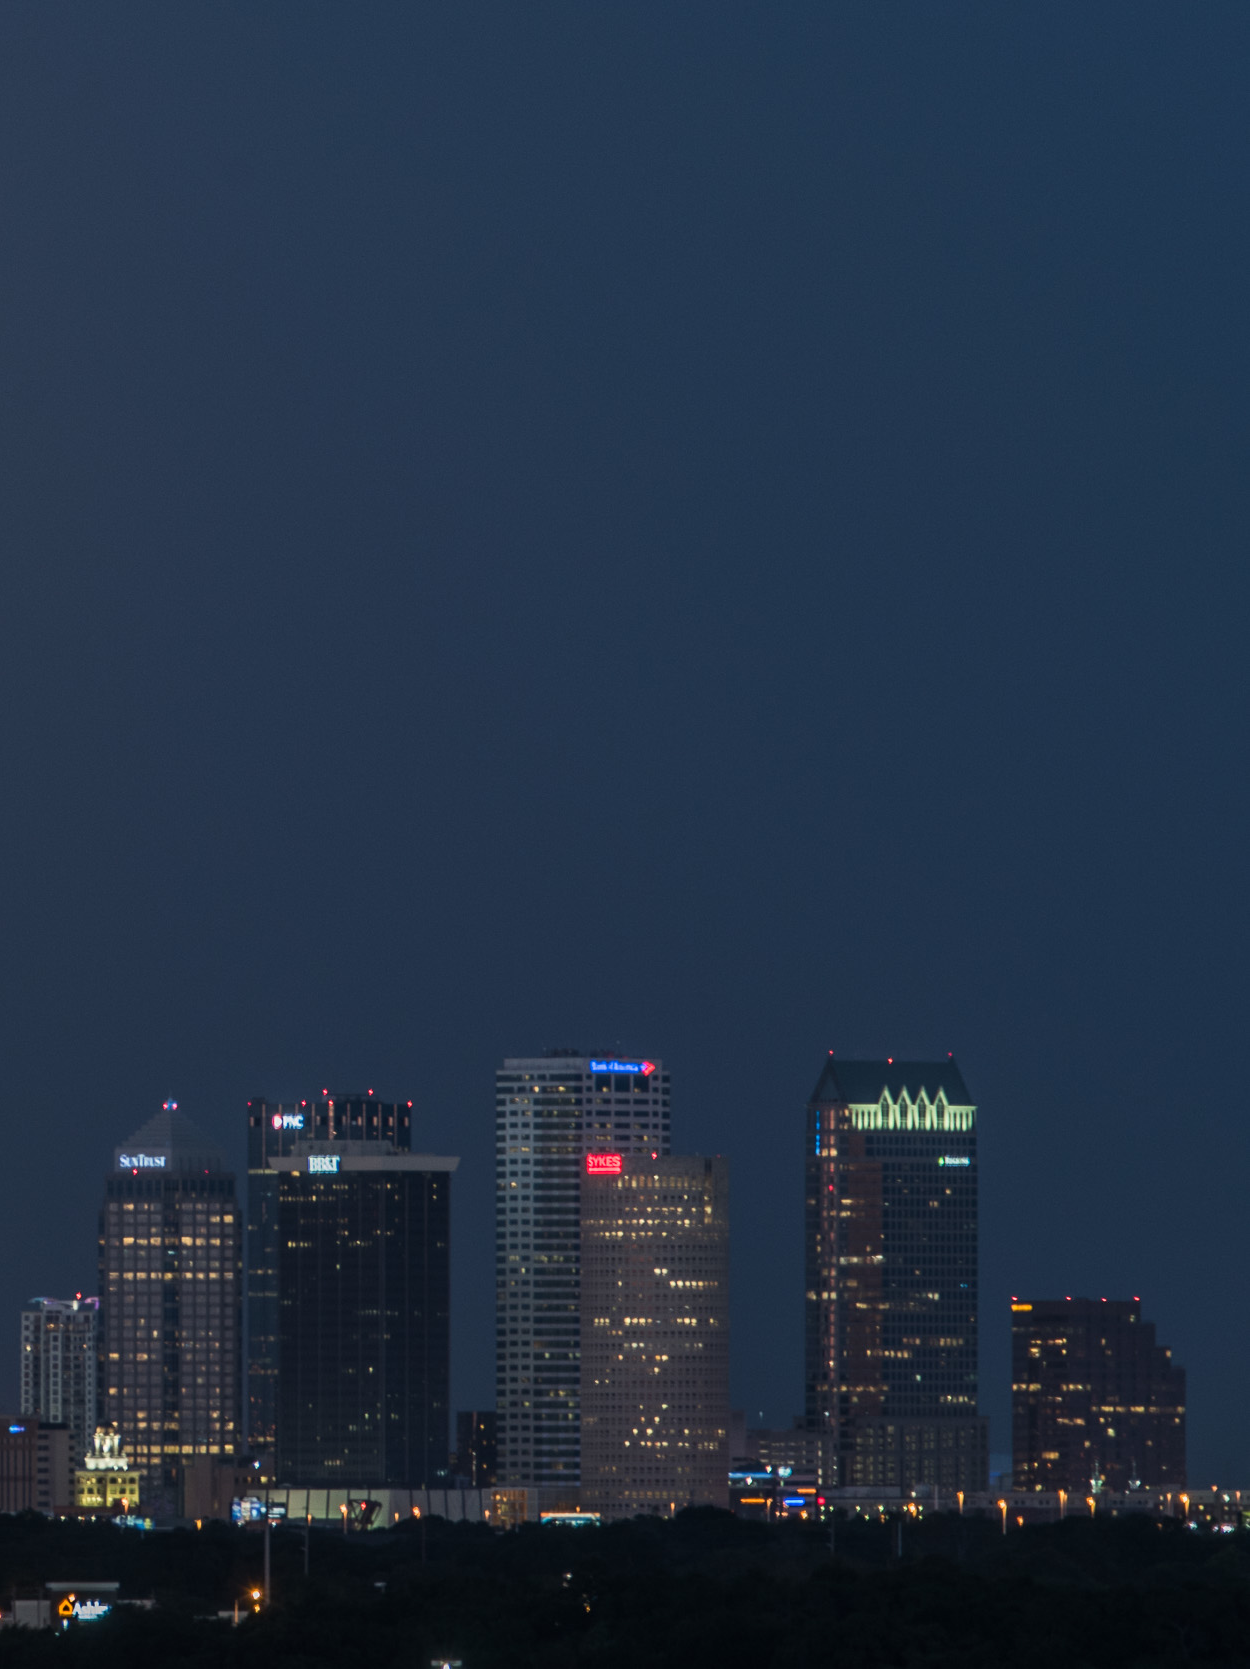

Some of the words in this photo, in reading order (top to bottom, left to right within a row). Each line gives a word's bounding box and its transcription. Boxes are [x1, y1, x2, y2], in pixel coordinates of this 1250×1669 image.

[282, 1114, 304, 1129] PNC
[119, 1153, 166, 1168] SUNTRUST
[308, 1155, 340, 1173] BB&T
[587, 1154, 621, 1167] SYKES
